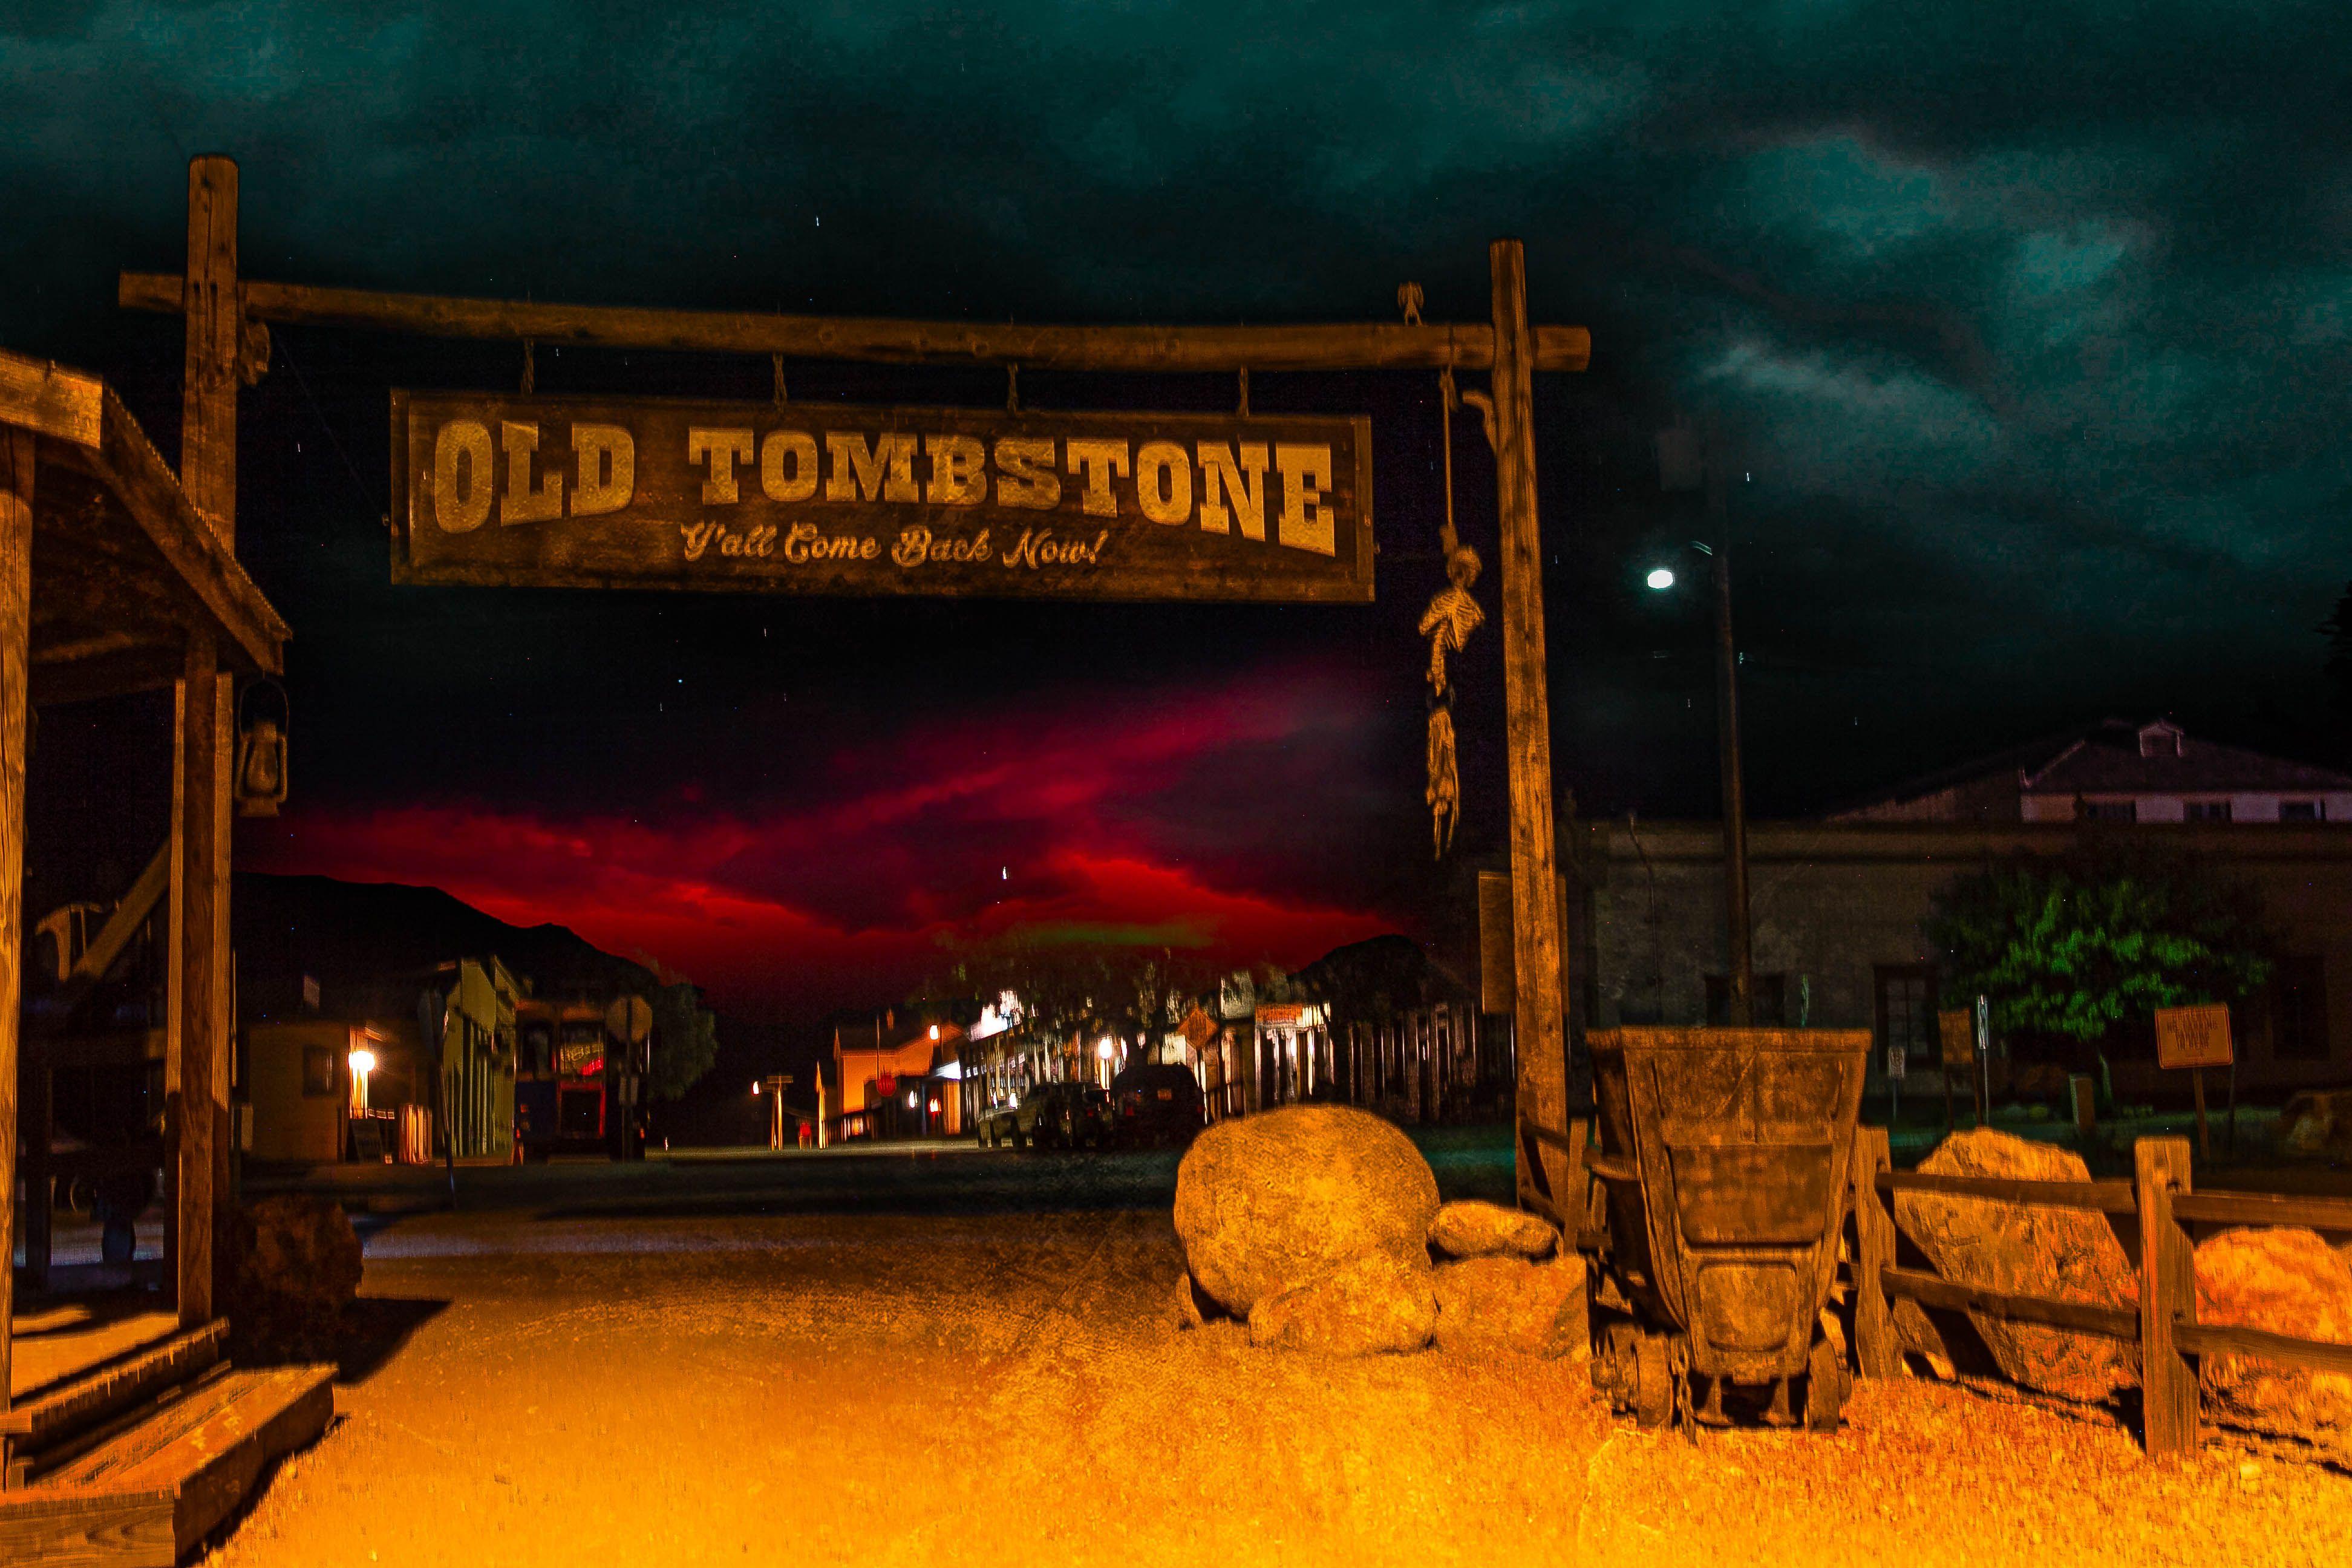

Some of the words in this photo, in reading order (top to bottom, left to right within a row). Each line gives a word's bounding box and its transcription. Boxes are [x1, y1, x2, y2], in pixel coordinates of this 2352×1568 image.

[435, 420, 635, 534] OLD
[688, 426, 1335, 557] TOMBSTONE
[681, 520, 777, 561] Y'all
[785, 521, 881, 564] Come
[891, 523, 993, 567] Back
[1002, 526, 1109, 569] Now!
